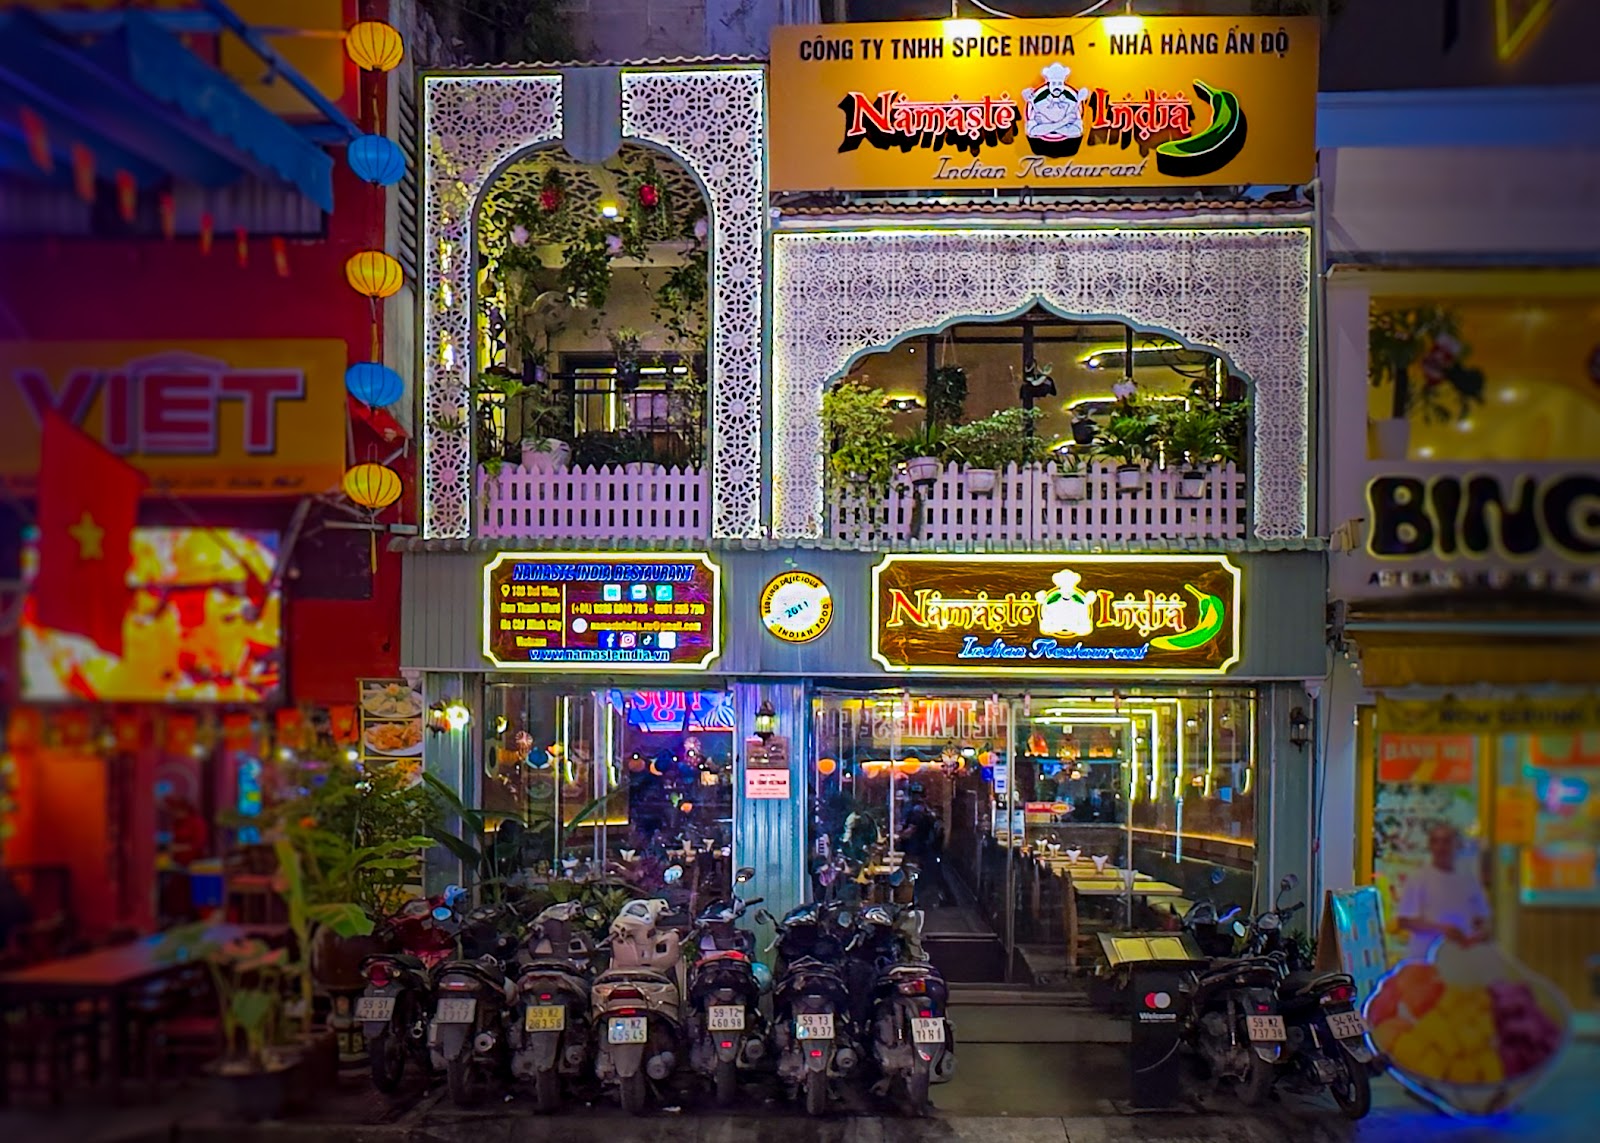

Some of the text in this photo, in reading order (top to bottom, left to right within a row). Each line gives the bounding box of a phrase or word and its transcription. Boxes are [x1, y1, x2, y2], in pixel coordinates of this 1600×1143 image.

[800, 34, 853, 61] CÔNG
[860, 39, 884, 60] TY
[891, 38, 943, 60] TNHH
[952, 36, 1011, 58] SPICE
[1019, 35, 1075, 57] INDIA
[1110, 29, 1153, 55] NHÀ
[1161, 28, 1219, 55] HÀNG
[1261, 27, 1289, 58] ĐỘ
[847, 87, 1192, 140] Namaste India
[933, 155, 1148, 180] Indian Restaurant
[512, 563, 696, 582] NAMASTE INDIA RESTAURANT
[785, 600, 809, 619] 2011
[886, 588, 1187, 637] Namaste India
[778, 626, 814, 638] INDIAN
[958, 635, 1150, 659] Indian Restaurant
[1139, 1012, 1177, 1020] Welcome
